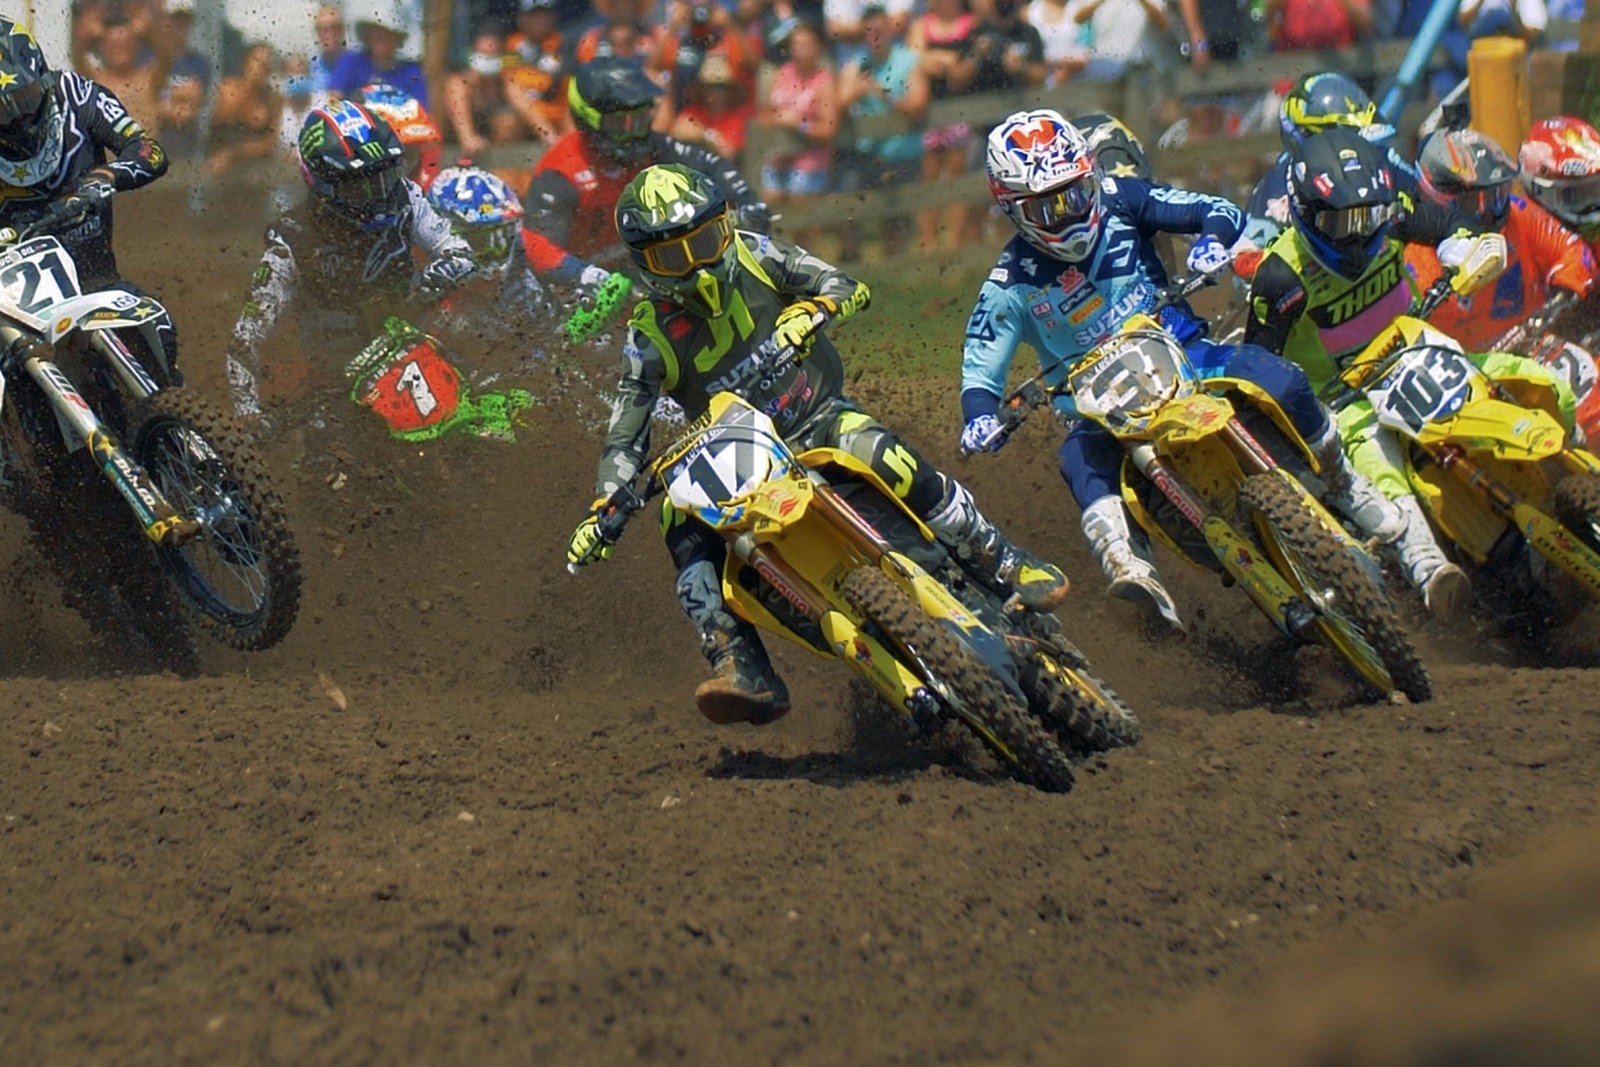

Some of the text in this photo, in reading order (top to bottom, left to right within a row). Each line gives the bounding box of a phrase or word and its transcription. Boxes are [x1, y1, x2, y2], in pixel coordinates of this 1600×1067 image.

[1, 252, 78, 315] 21
[1073, 283, 1147, 346] SUZUKI
[1327, 262, 1398, 325] THOR
[396, 361, 438, 416] 1
[1386, 347, 1467, 434] 103
